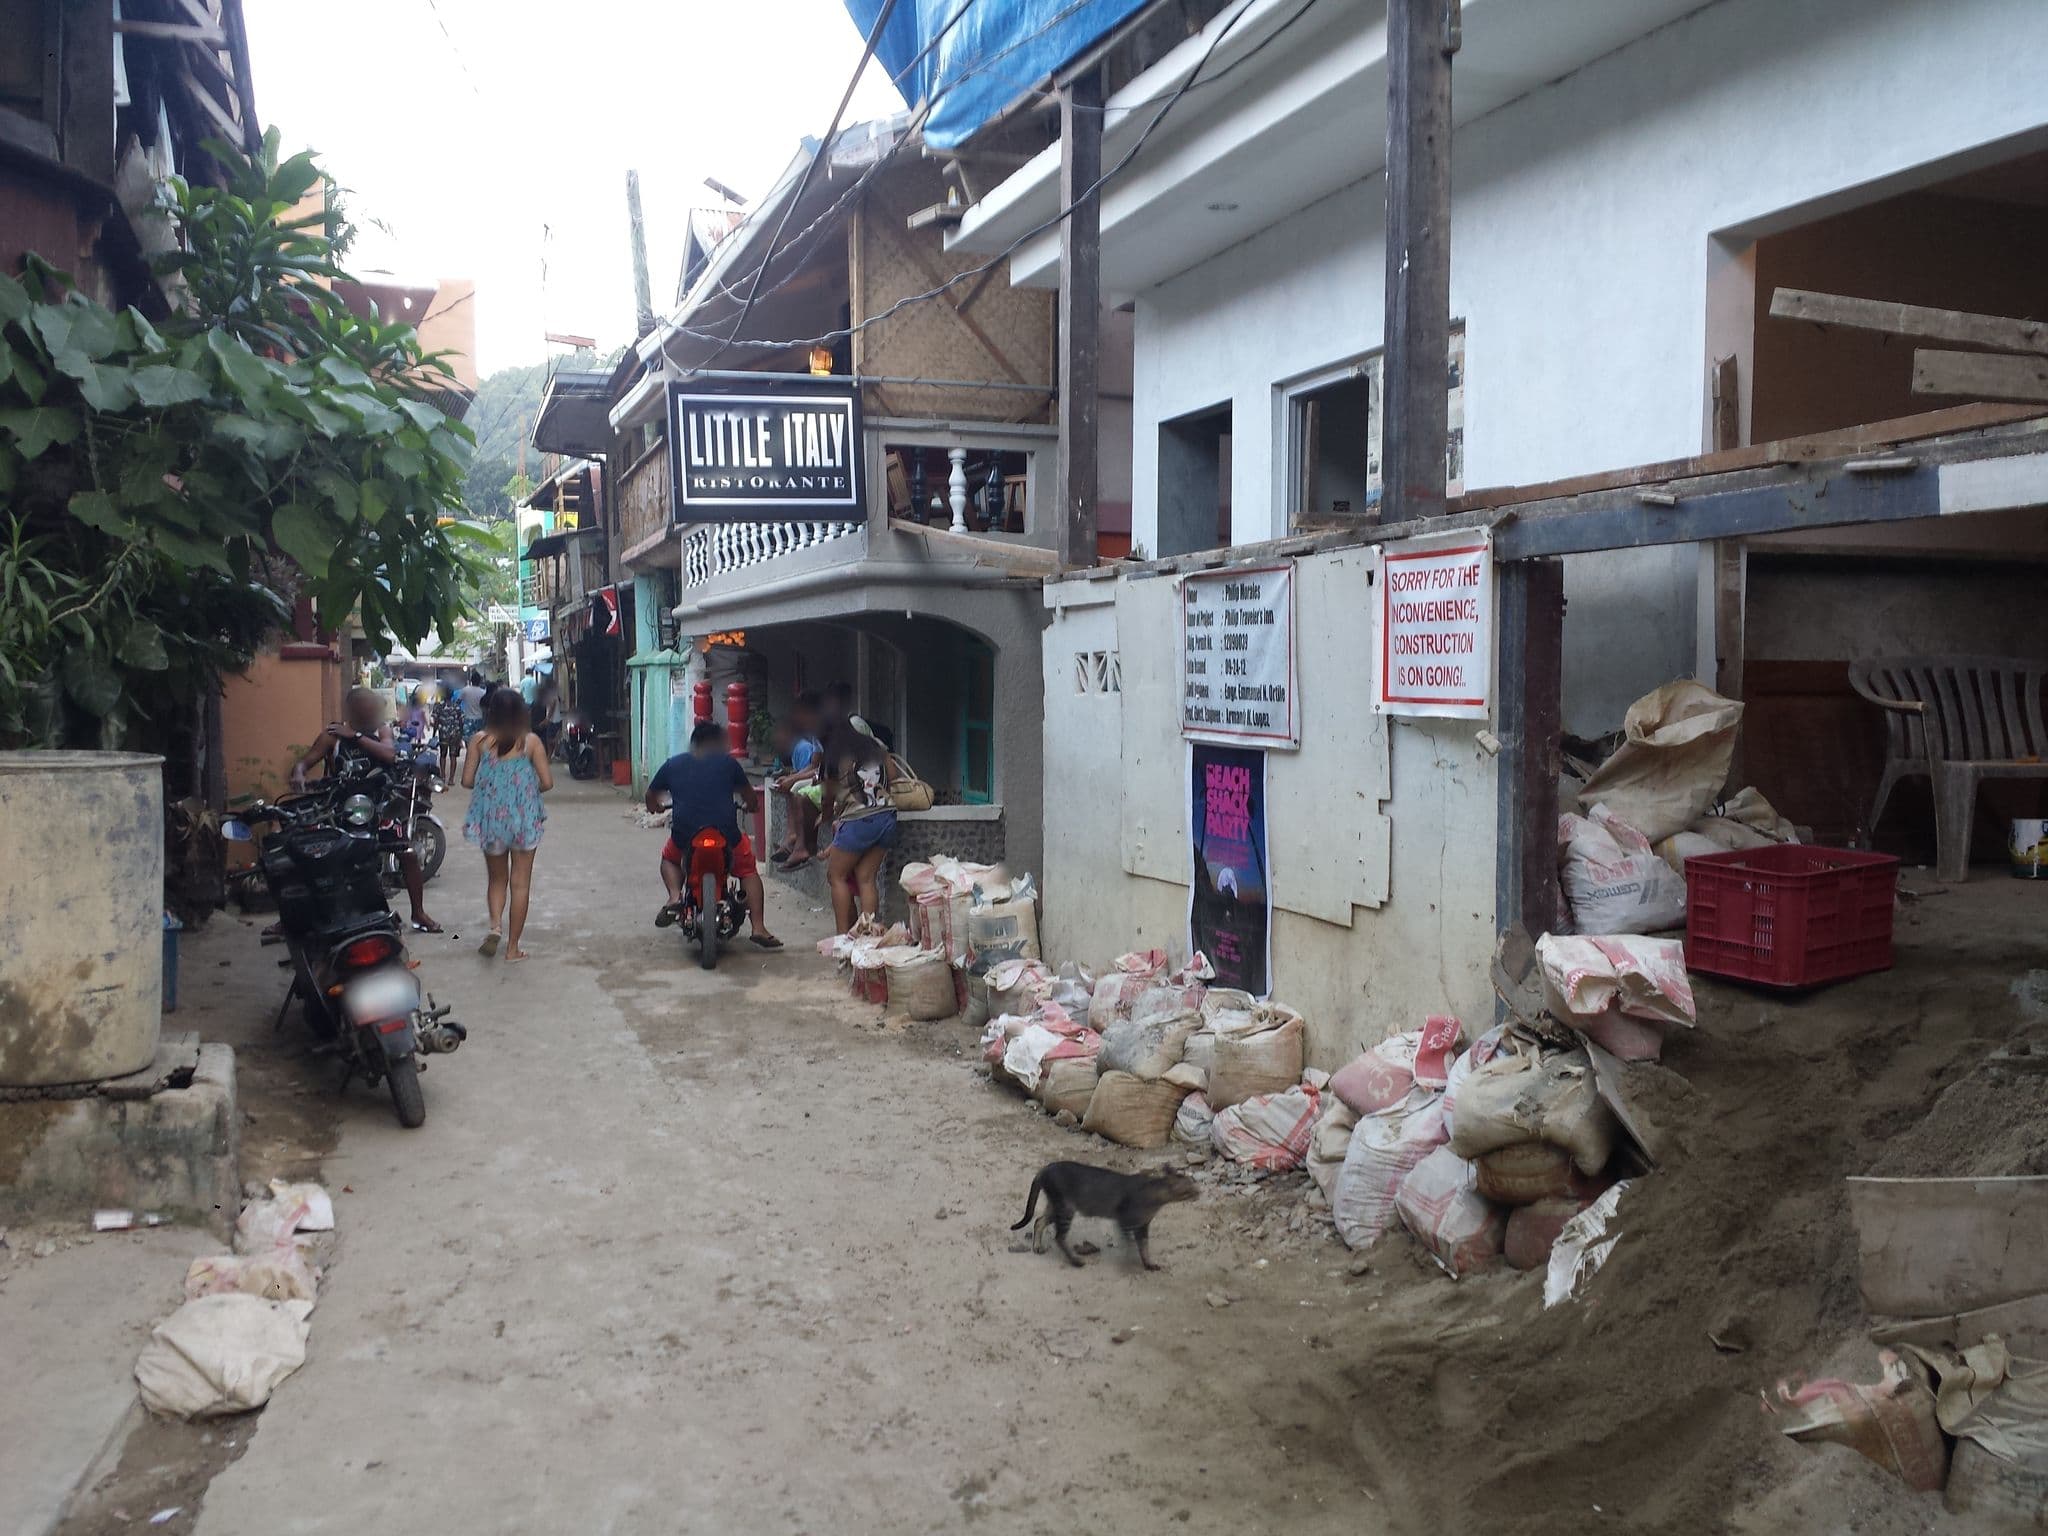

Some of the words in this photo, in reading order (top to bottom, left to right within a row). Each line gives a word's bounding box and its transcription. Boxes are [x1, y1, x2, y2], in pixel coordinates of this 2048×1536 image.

[689, 411, 773, 468] LITTLE
[783, 412, 845, 468] ITALY
[693, 475, 846, 489] RISTORANTE
[1391, 568, 1431, 593] SORRY
[1432, 567, 1456, 590] FOR
[1457, 564, 1481, 587] THE
[1263, 607, 1275, 625] Inn
[1394, 631, 1474, 655] CONSTRUCTION
[1397, 665, 1406, 686] IS
[1407, 665, 1423, 686] ON
[1206, 764, 1250, 795] BEACH
